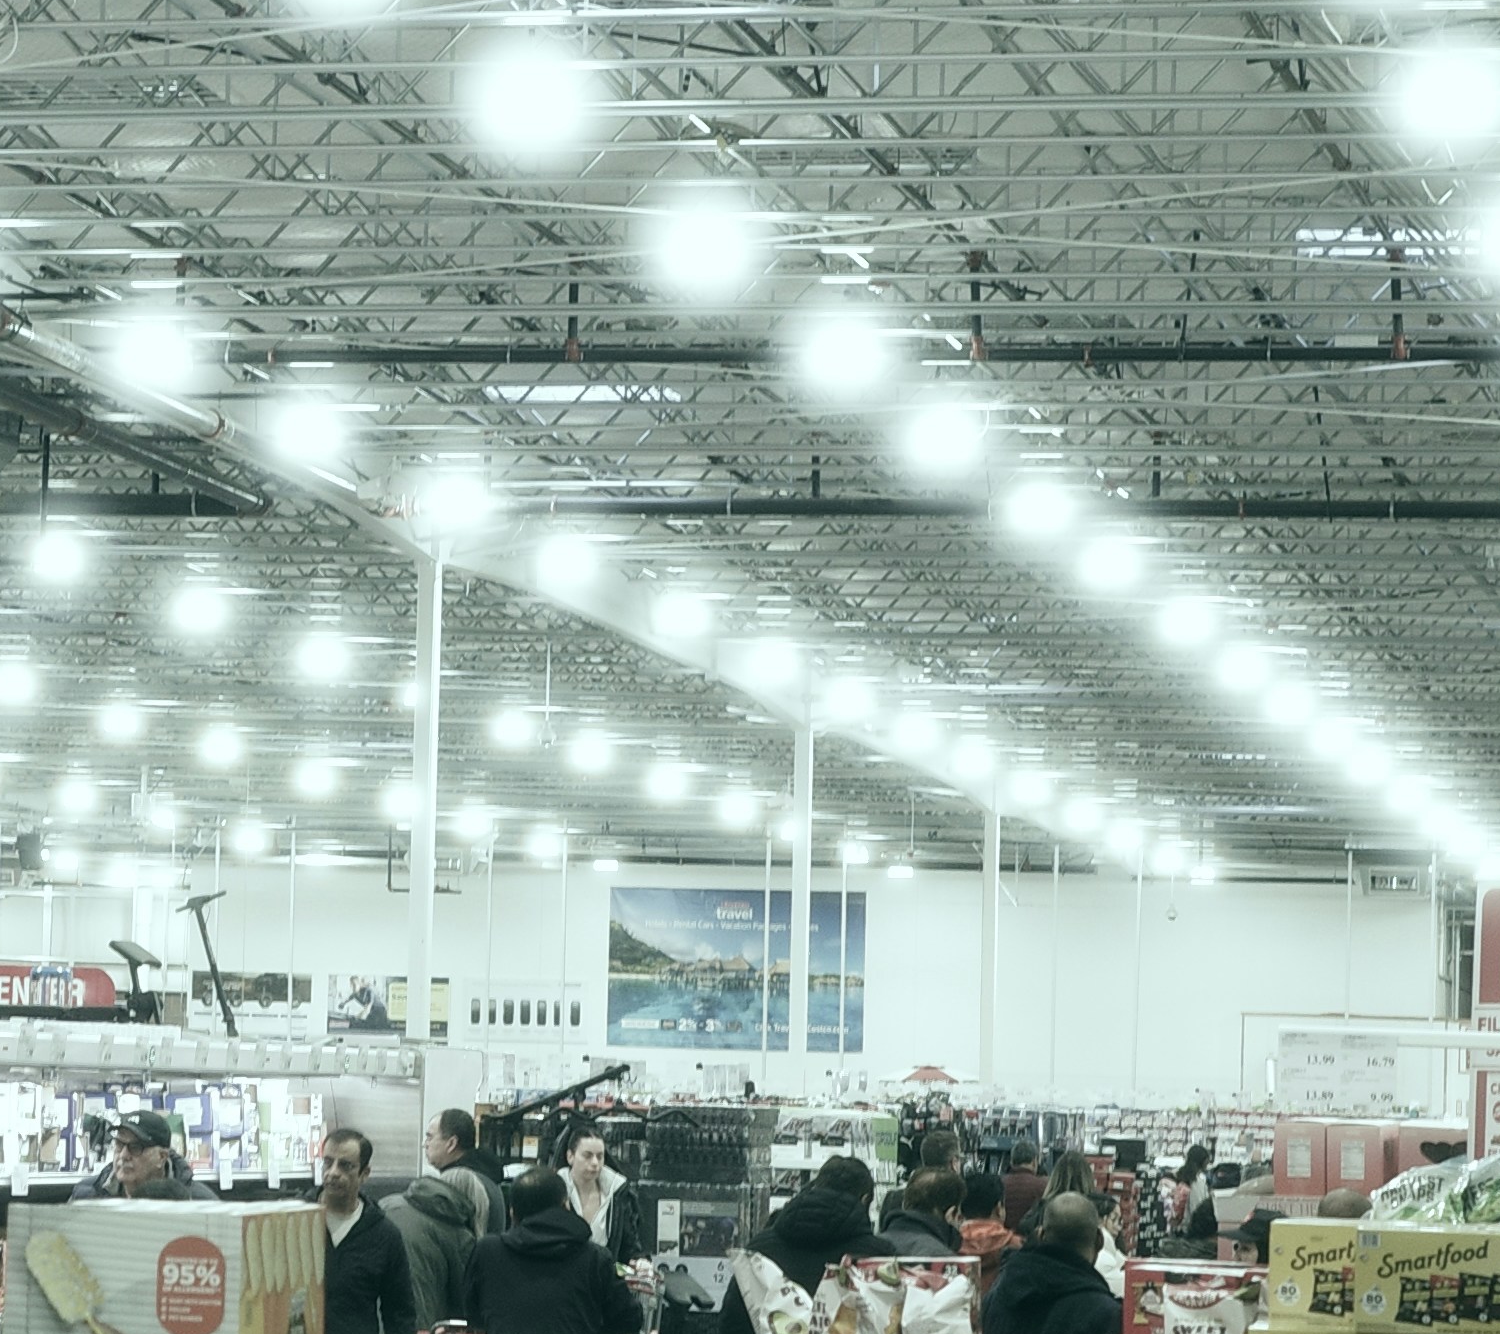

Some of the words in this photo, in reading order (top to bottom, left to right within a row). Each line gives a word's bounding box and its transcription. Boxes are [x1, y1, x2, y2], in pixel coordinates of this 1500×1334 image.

[717, 908, 753, 920] travel
[1377, 1240, 1489, 1279] Smartfood
[163, 1264, 220, 1287] 95%
